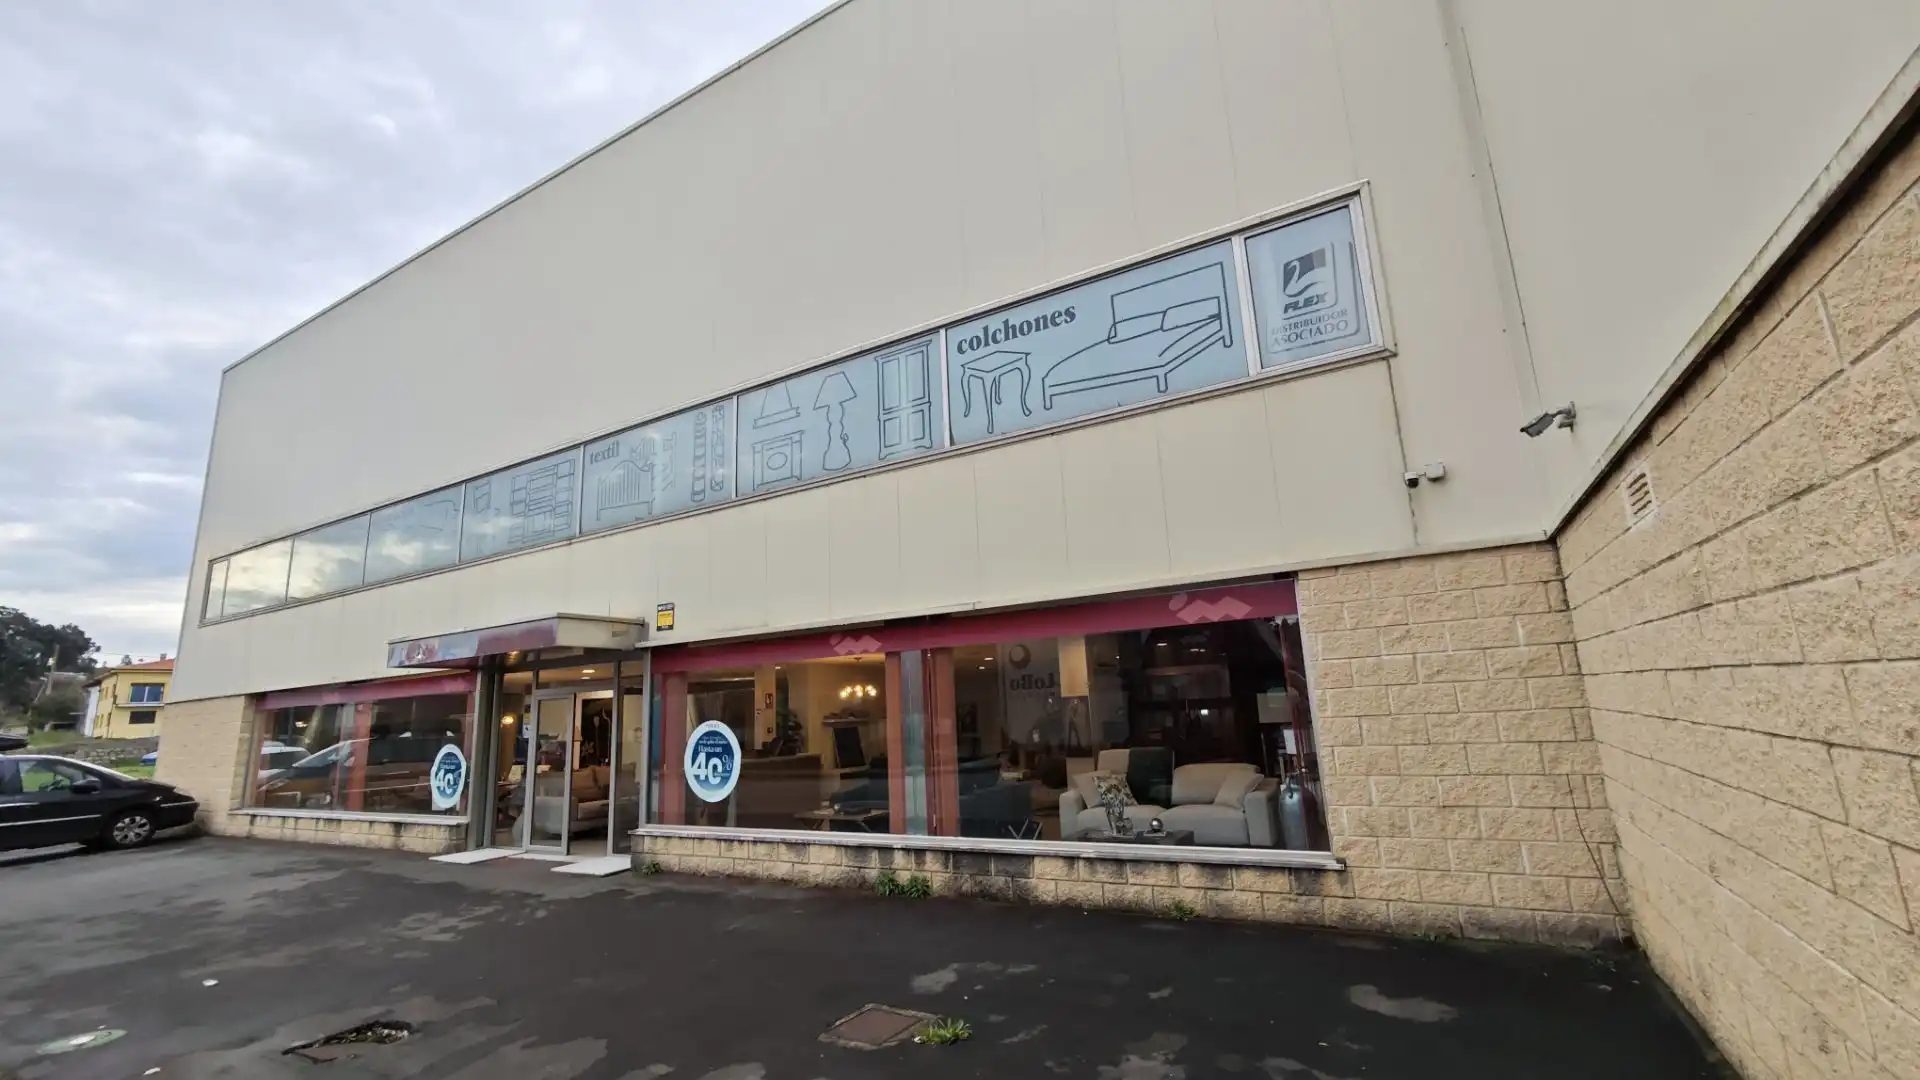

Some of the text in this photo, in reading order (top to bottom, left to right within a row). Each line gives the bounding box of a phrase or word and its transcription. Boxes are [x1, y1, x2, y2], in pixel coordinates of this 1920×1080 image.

[1283, 292, 1329, 314] FLEX
[956, 305, 1077, 355] colchones
[1271, 319, 1349, 347] ASOCIADO
[1272, 308, 1348, 336] DISTRIBUIDOR
[589, 440, 620, 465] textil
